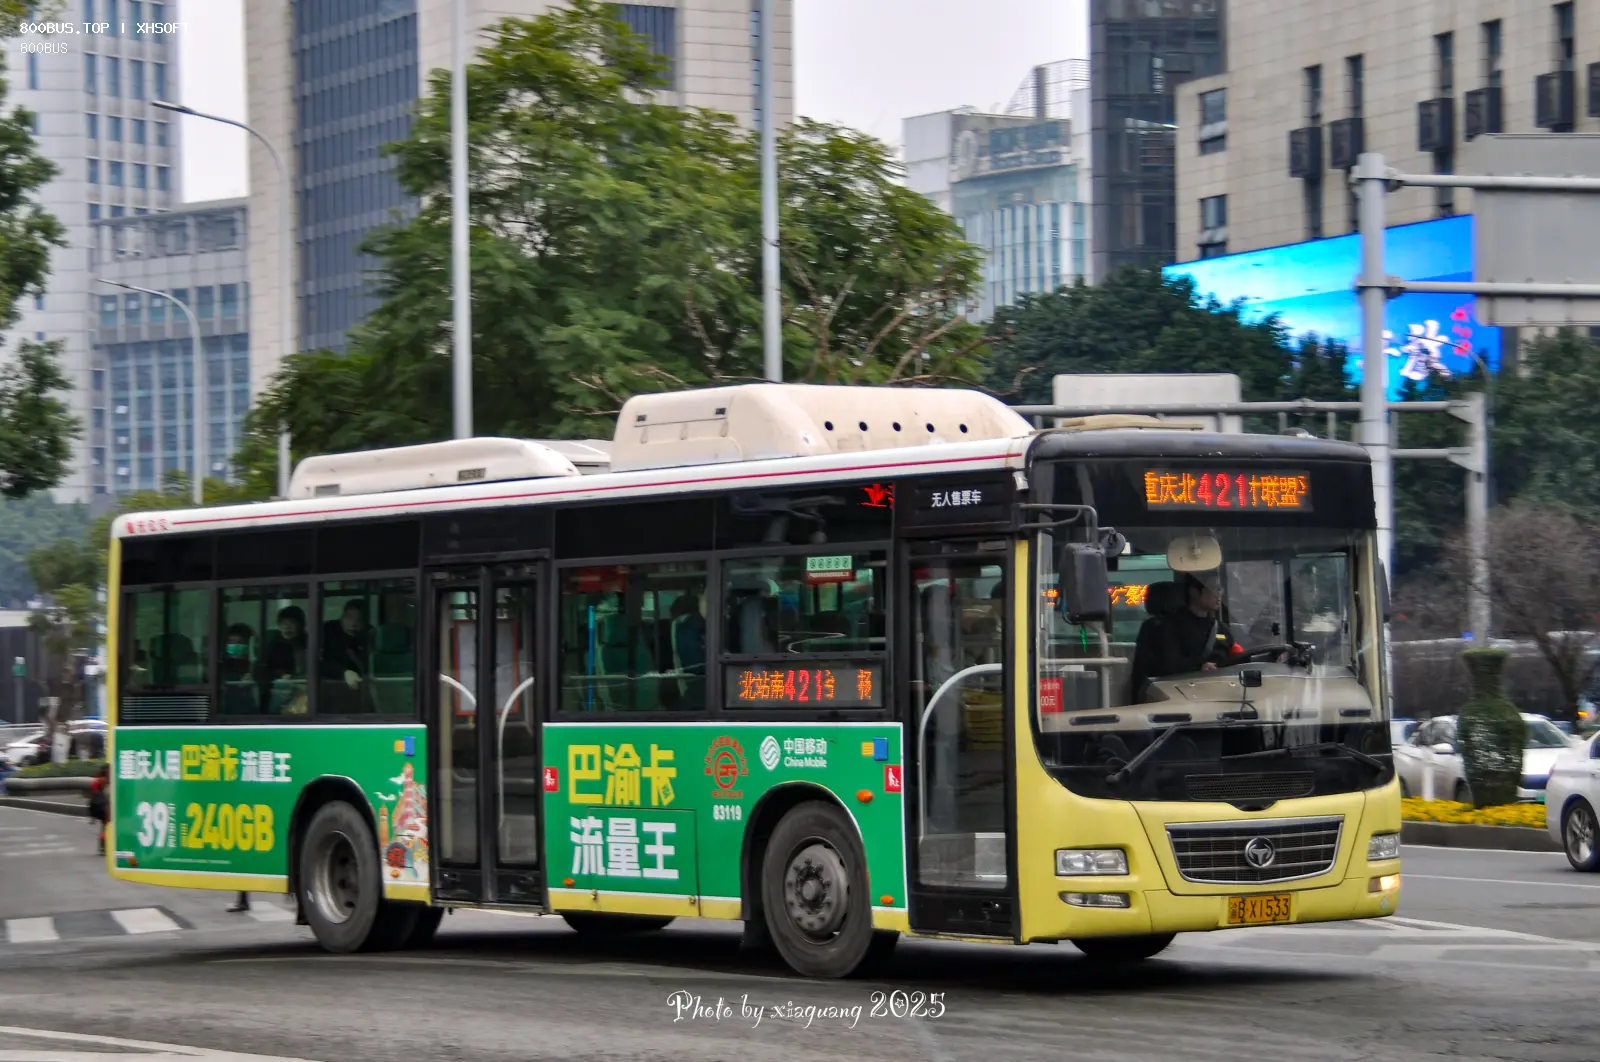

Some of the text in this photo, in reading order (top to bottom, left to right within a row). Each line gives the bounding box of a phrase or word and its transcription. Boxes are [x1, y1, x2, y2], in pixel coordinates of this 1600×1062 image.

[931, 489, 982, 508] 无人售票车
[1197, 473, 1245, 507] 421
[785, 669, 824, 701] 421
[783, 737, 828, 755] 中国移动
[568, 743, 677, 807] 巴渝卡
[783, 756, 828, 769] China Mobile
[136, 801, 167, 848] 39
[186, 802, 275, 852] 240GB
[712, 804, 742, 821] 83119
[570, 816, 680, 880] 流量王
